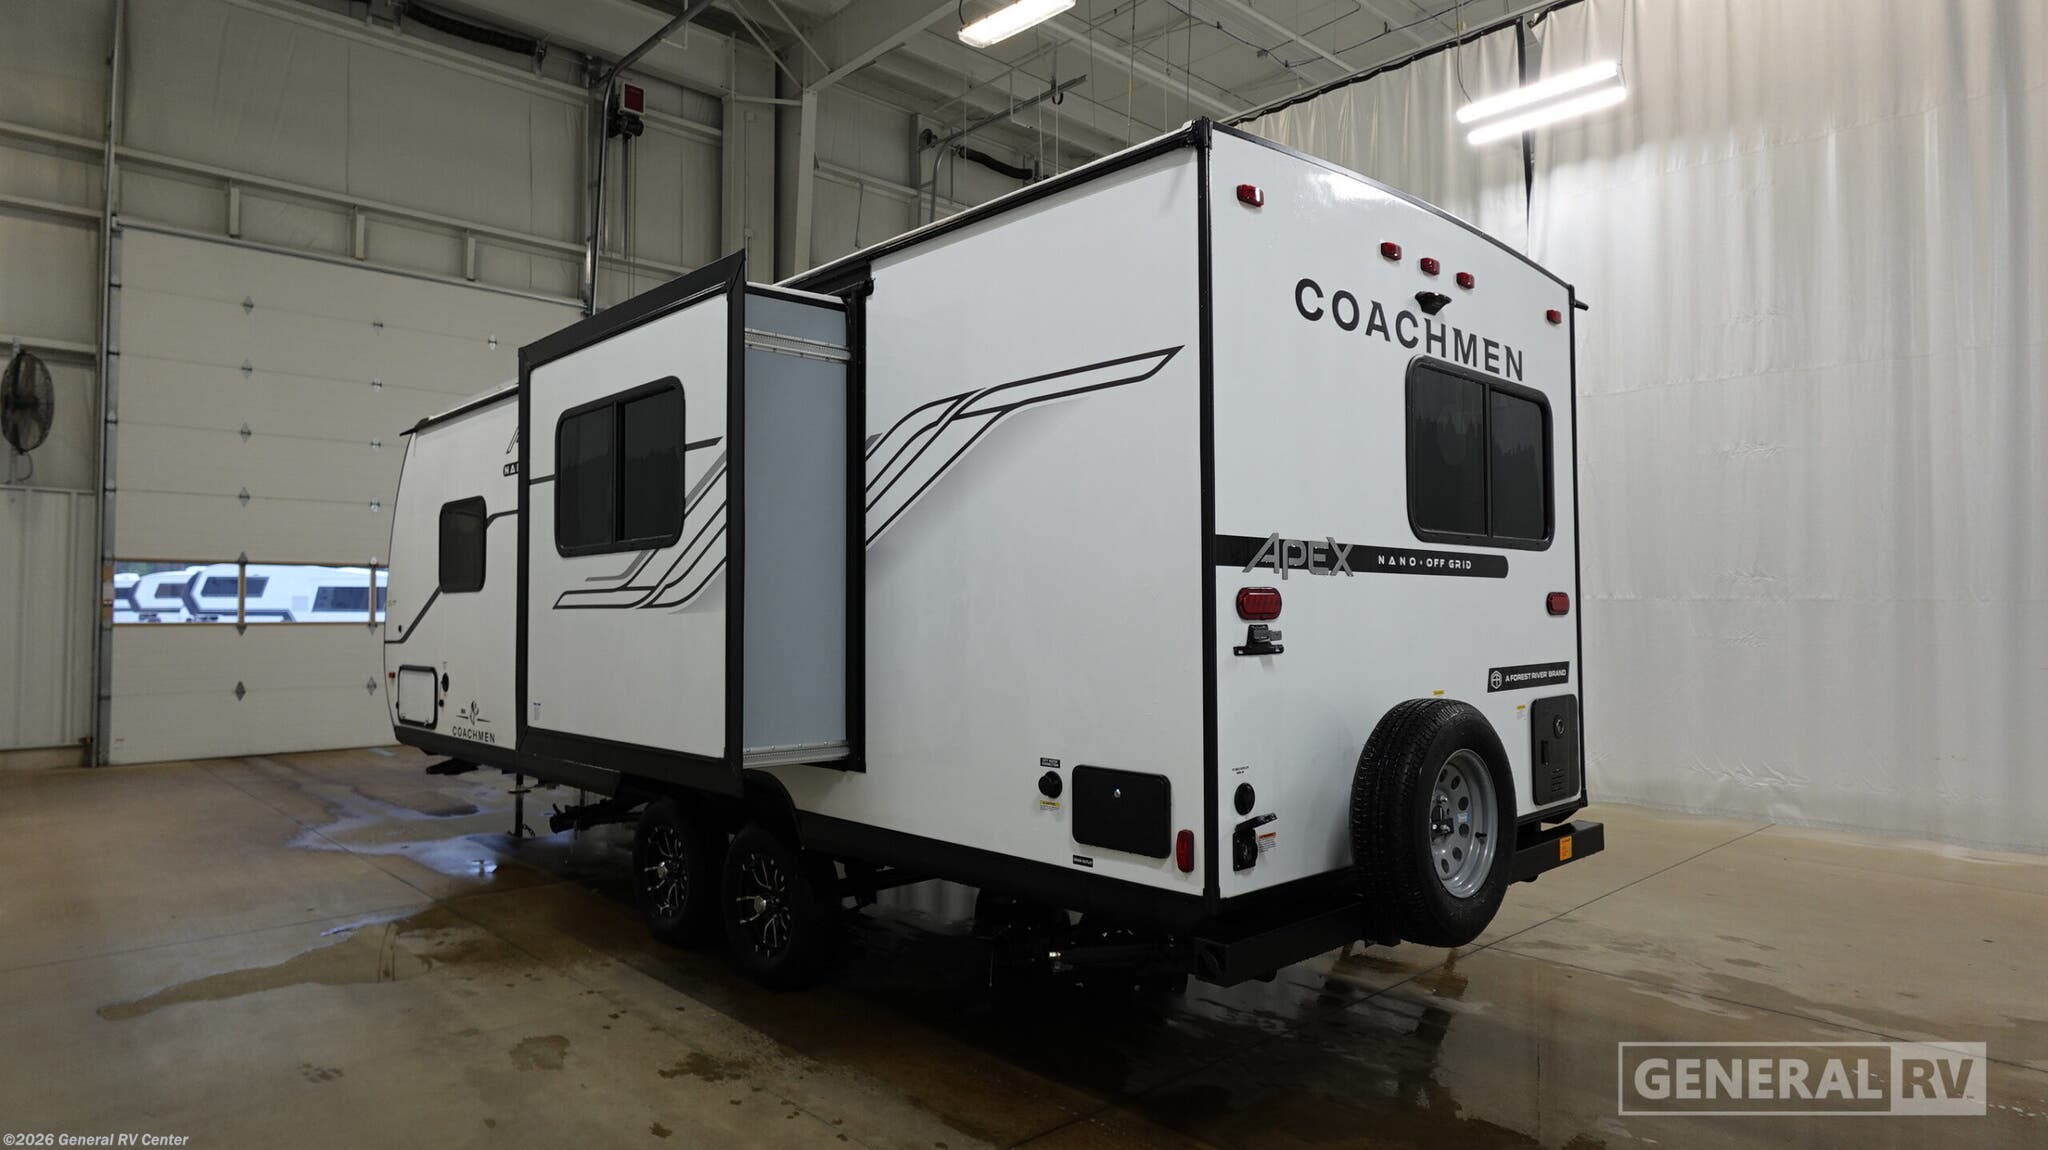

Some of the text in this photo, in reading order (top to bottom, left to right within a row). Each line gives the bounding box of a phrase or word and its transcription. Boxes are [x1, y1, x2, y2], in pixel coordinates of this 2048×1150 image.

[1295, 278, 1524, 382] COACHMEN
[1242, 533, 1354, 580] APEX
[1378, 555, 1472, 570] NANO OFF GRID
[1510, 672, 1531, 682] FOREST
[1531, 671, 1547, 679] RIVER
[1548, 669, 1567, 678] BRAND
[452, 726, 496, 743] COACHMEN
